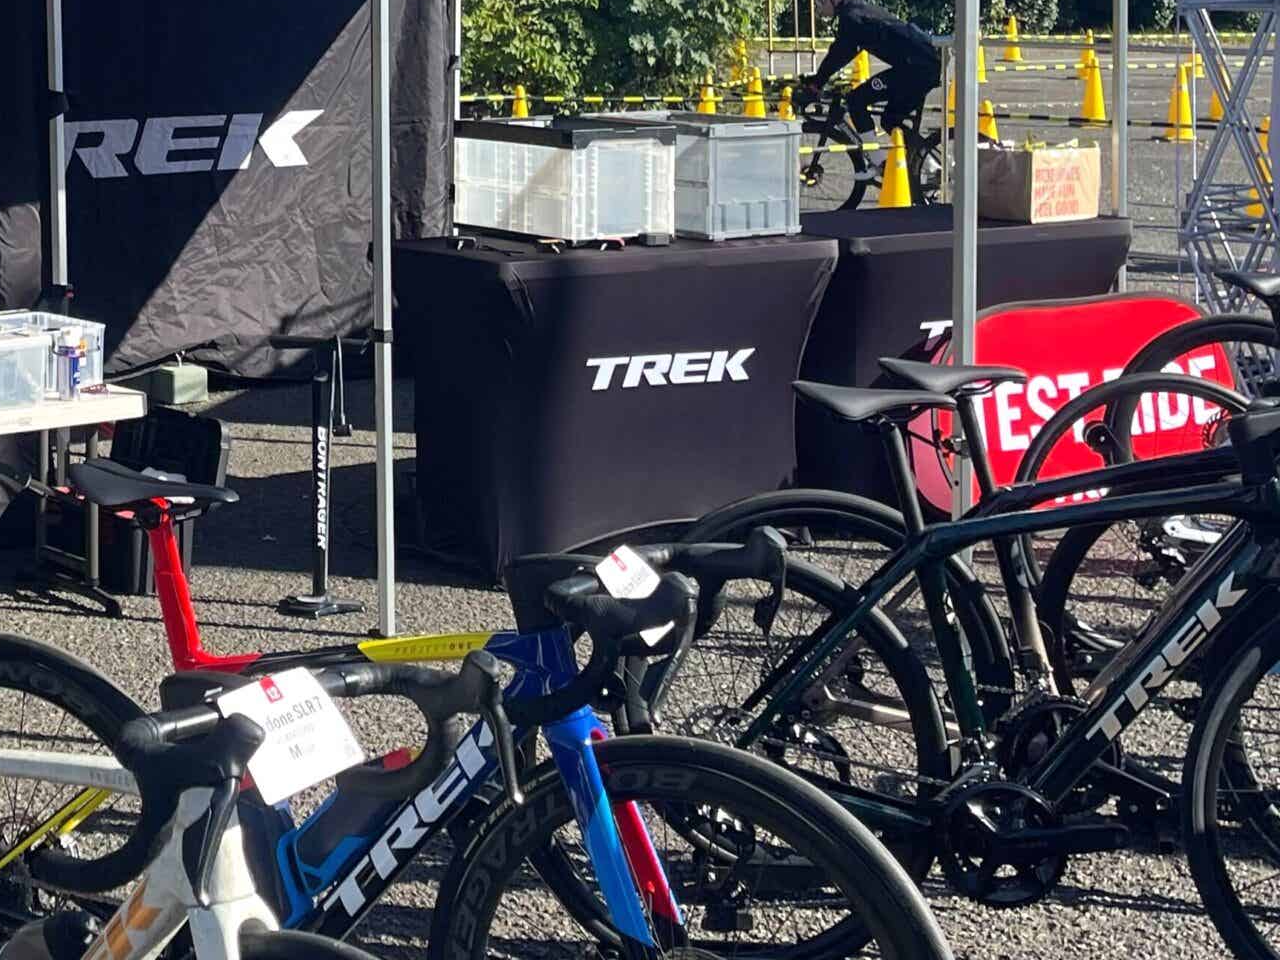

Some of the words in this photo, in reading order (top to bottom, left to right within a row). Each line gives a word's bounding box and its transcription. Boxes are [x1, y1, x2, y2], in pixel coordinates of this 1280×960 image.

[63, 109, 325, 179] REK
[586, 347, 756, 391] TREK
[316, 426, 327, 551] BONTRAGER
[1085, 571, 1249, 741] TREK
[265, 711, 295, 733] done
[292, 696, 317, 720] SLR
[288, 743, 303, 761] M
[323, 720, 494, 918] TREK
